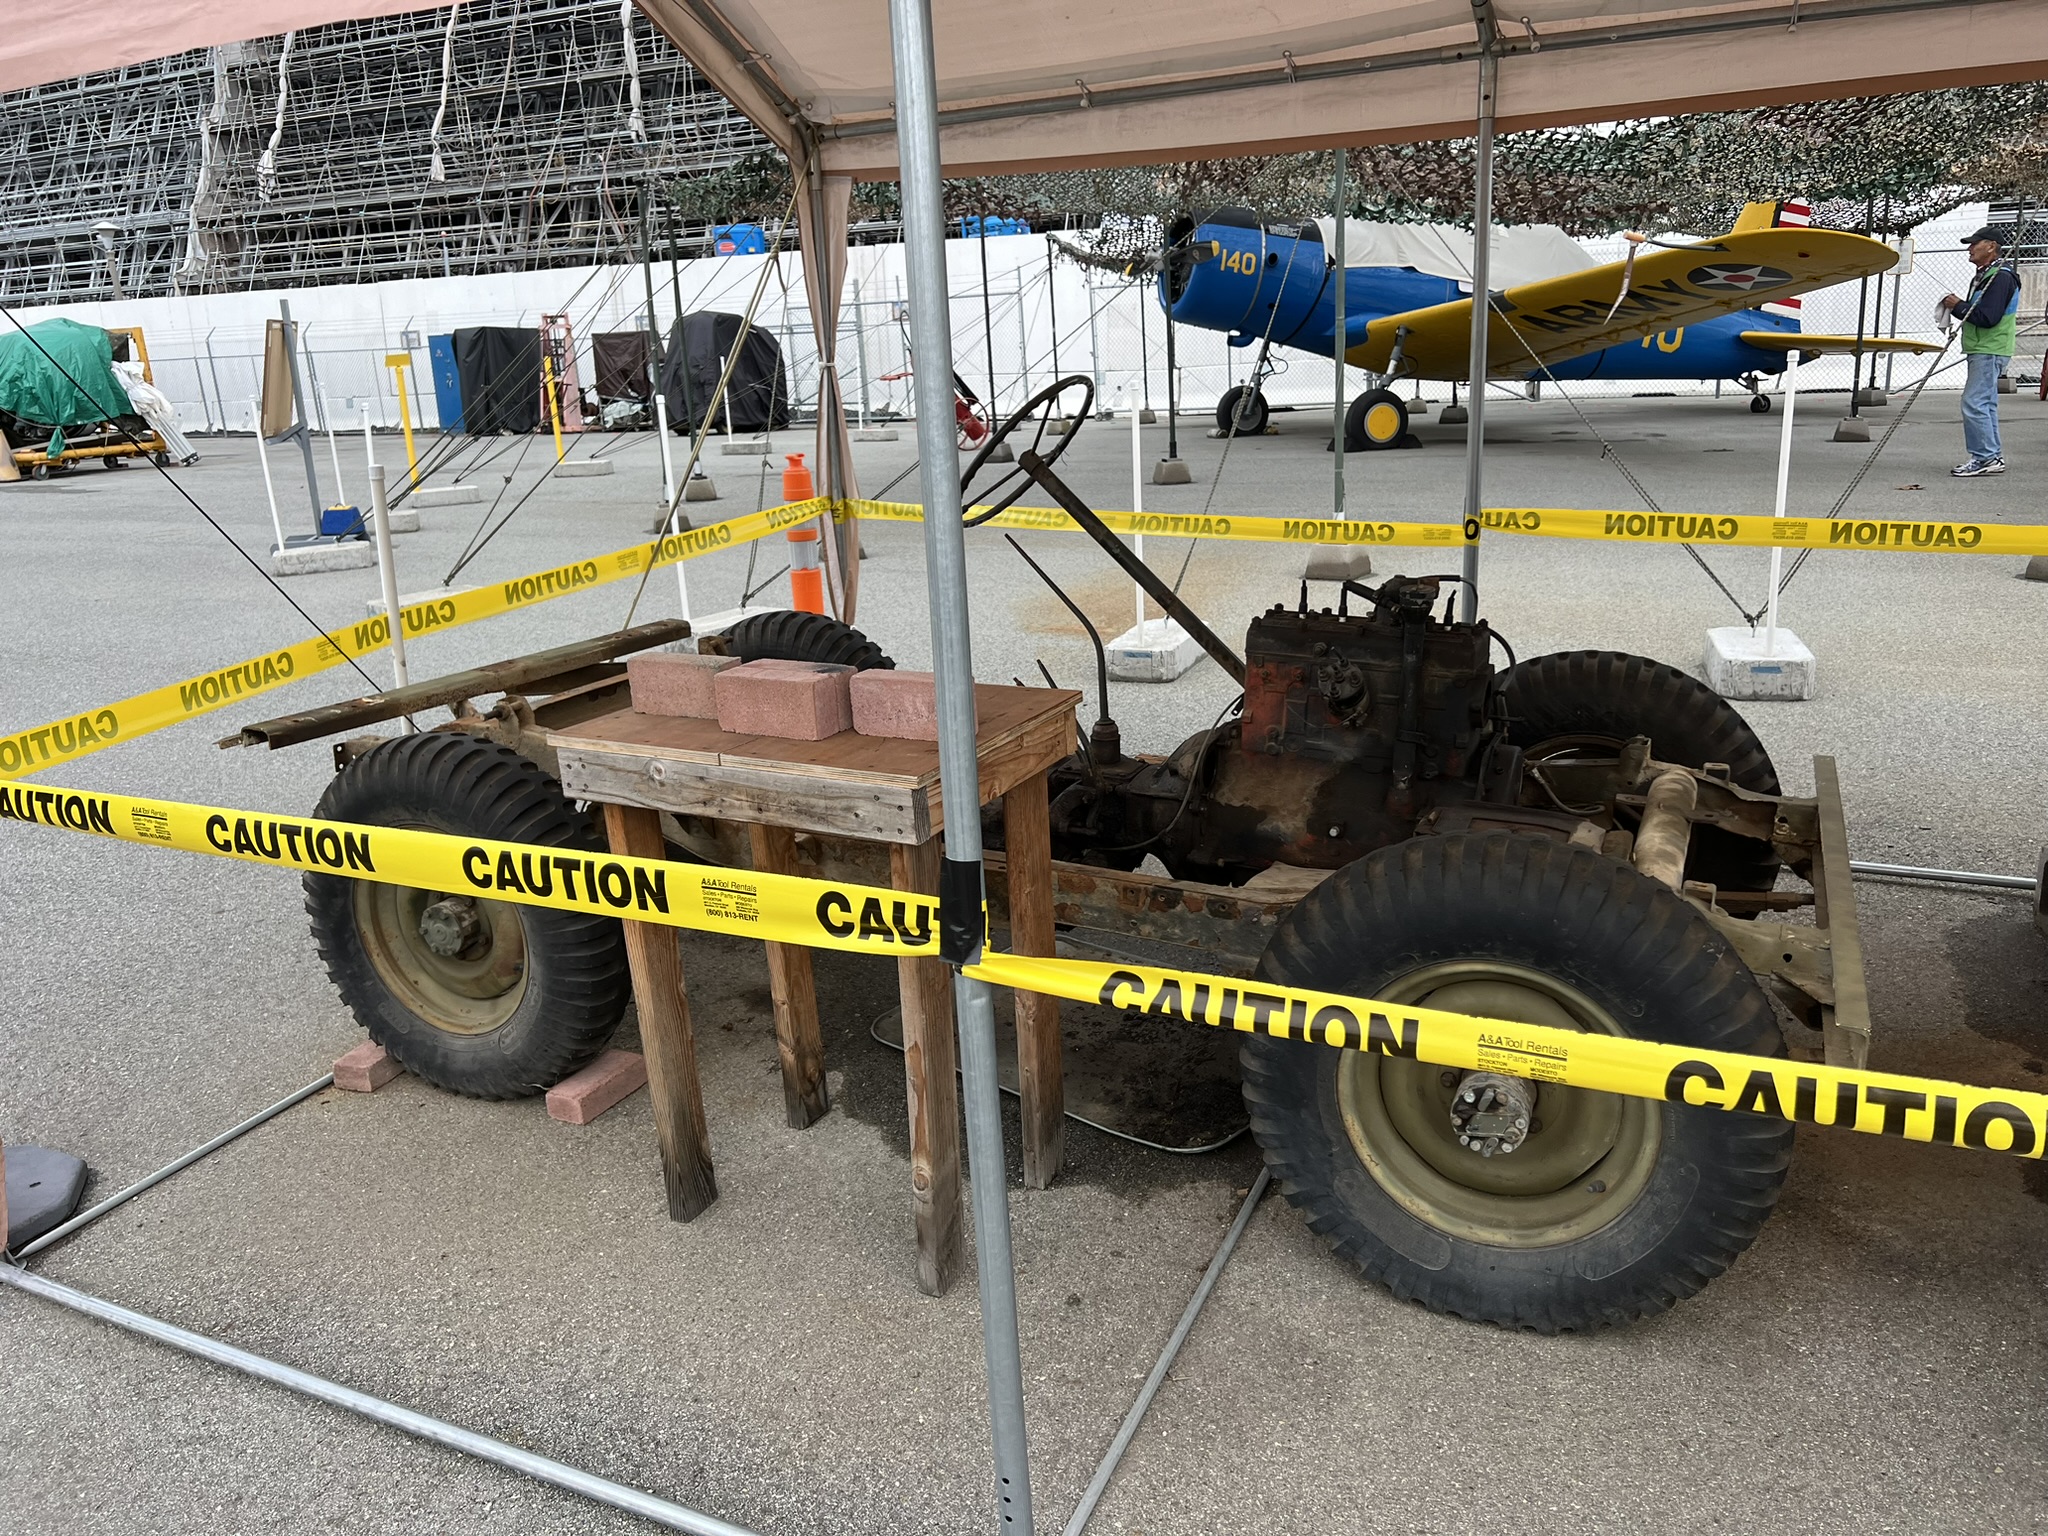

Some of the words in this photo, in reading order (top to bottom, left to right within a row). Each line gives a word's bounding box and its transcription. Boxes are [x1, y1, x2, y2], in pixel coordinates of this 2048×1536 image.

[1220, 249, 1257, 275] 140
[1519, 278, 1712, 334] ARMY
[0, 786, 117, 836] AUTION
[205, 814, 376, 872] CAUTION
[462, 846, 671, 914] CAUTION
[731, 881, 757, 892] Rentals
[816, 890, 941, 946] CAU
[1098, 970, 1420, 1061] CAUTION
[1477, 1048, 1501, 1059] Sales
[1507, 1053, 1528, 1064] Parts
[1534, 1058, 1567, 1071] Repairs
[1478, 1033, 1503, 1046] A&A
[1503, 1036, 1523, 1049] Tool
[1526, 1040, 1568, 1057] Rentals
[1665, 1060, 2048, 1160] CAUTIO
